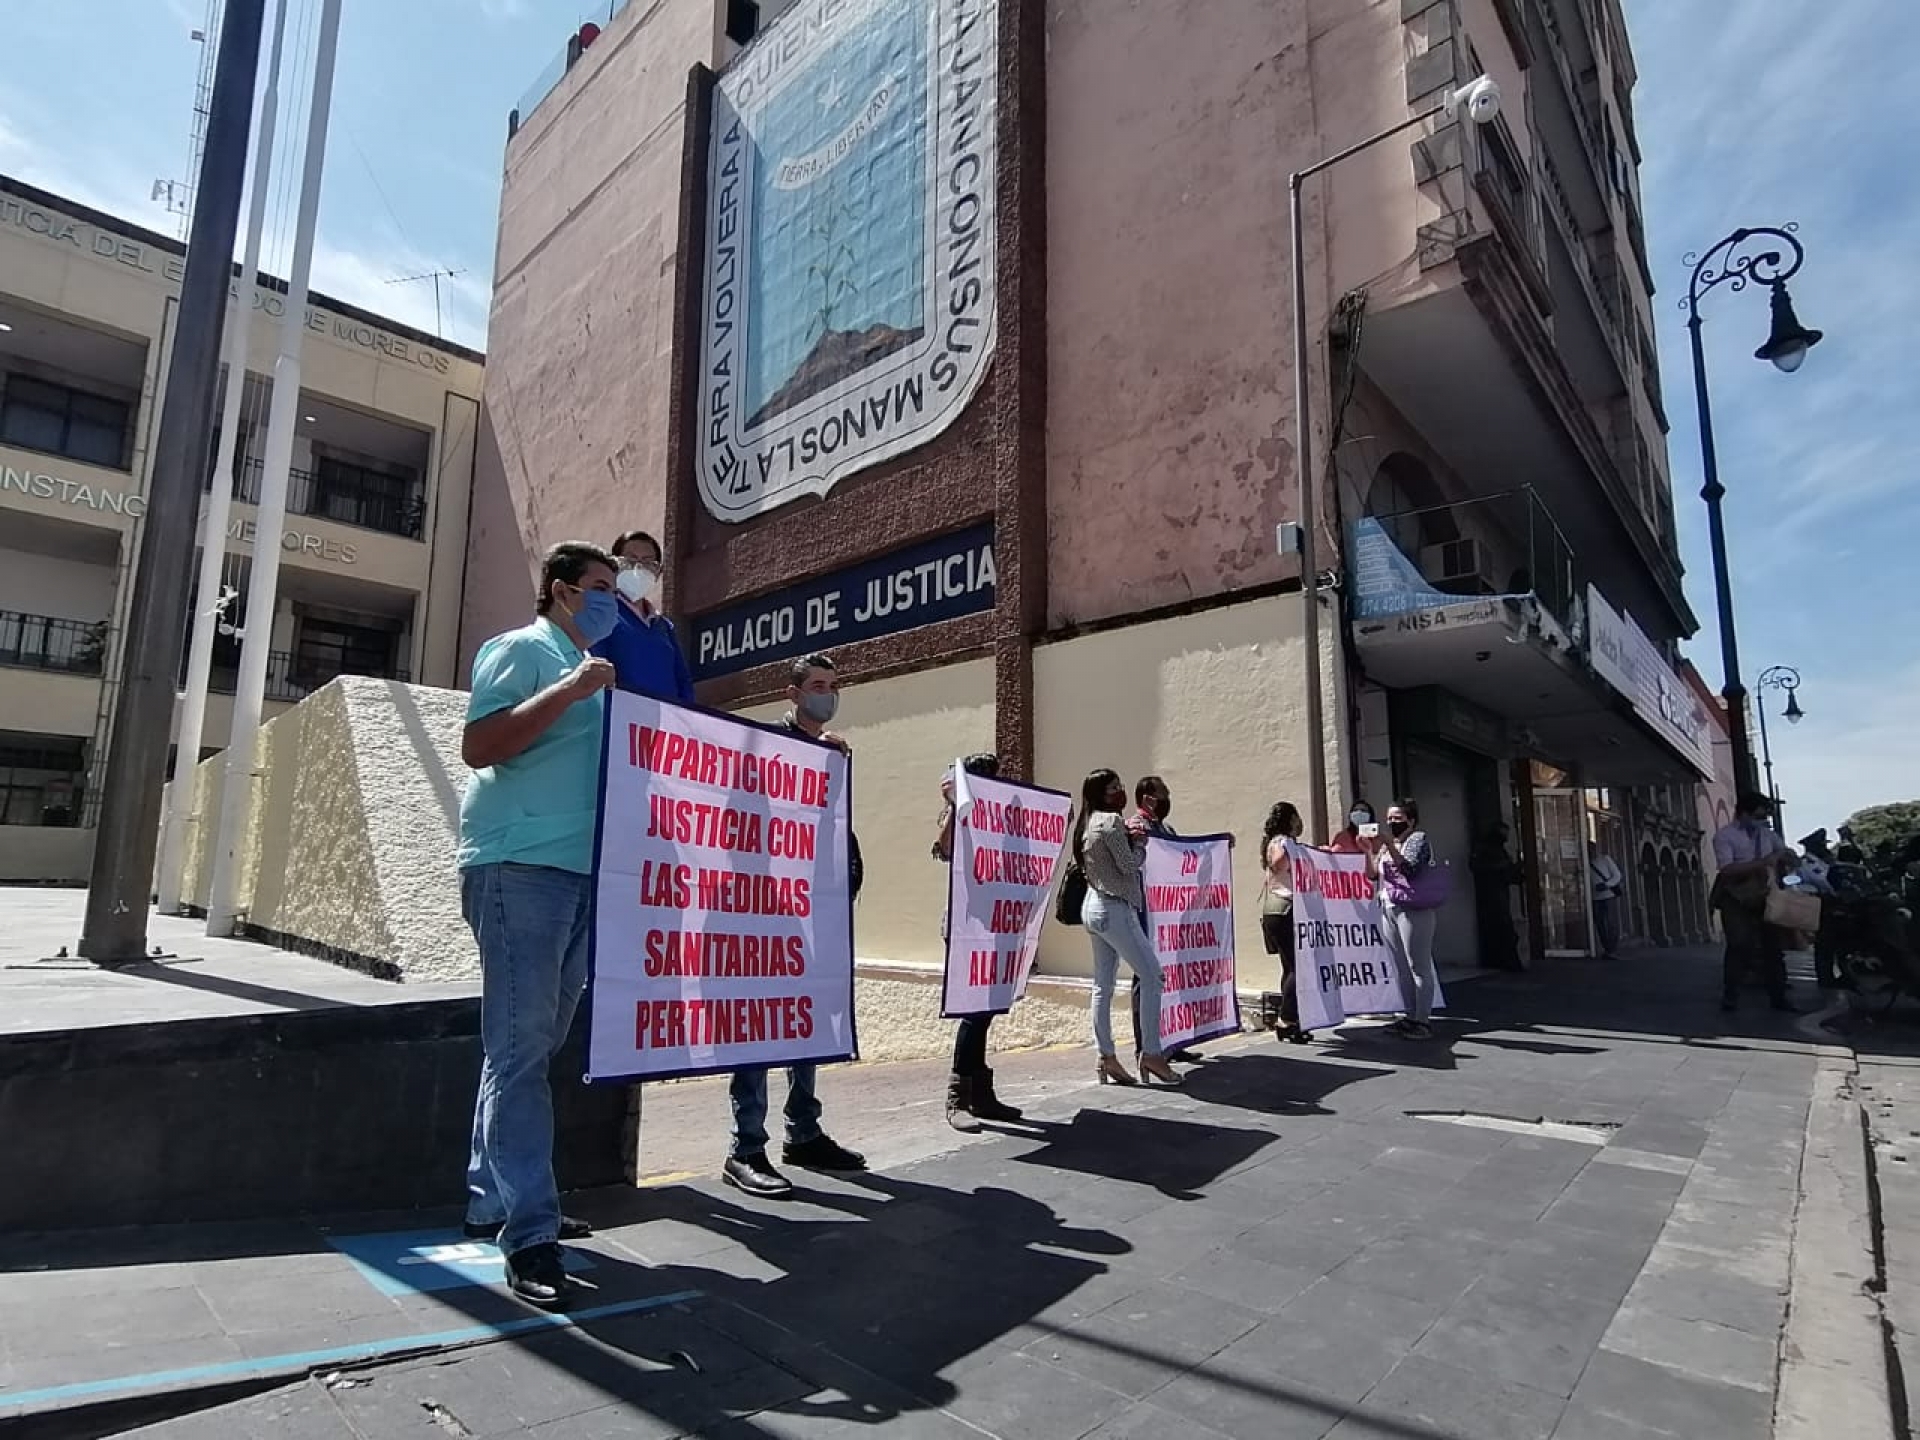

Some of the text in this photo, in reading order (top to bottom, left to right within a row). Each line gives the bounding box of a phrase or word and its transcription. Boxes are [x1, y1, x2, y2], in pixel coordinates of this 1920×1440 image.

[92, 236, 154, 273] DEL
[333, 318, 450, 374] MORELOS
[226, 518, 358, 564] MEORES
[699, 544, 997, 665] PALACIO DE JUSTICIA
[1398, 611, 1447, 632] NISA
[628, 721, 831, 808] IMPARTICIÓN DE
[646, 794, 815, 861] JUSTICIA CON
[1004, 803, 1065, 844] SOCIEDAD
[639, 859, 812, 918] LAS MEDIDAS
[973, 845, 1001, 886] QUE
[643, 928, 806, 979] SANITARIAS
[635, 994, 814, 1050] PERTINENTES
